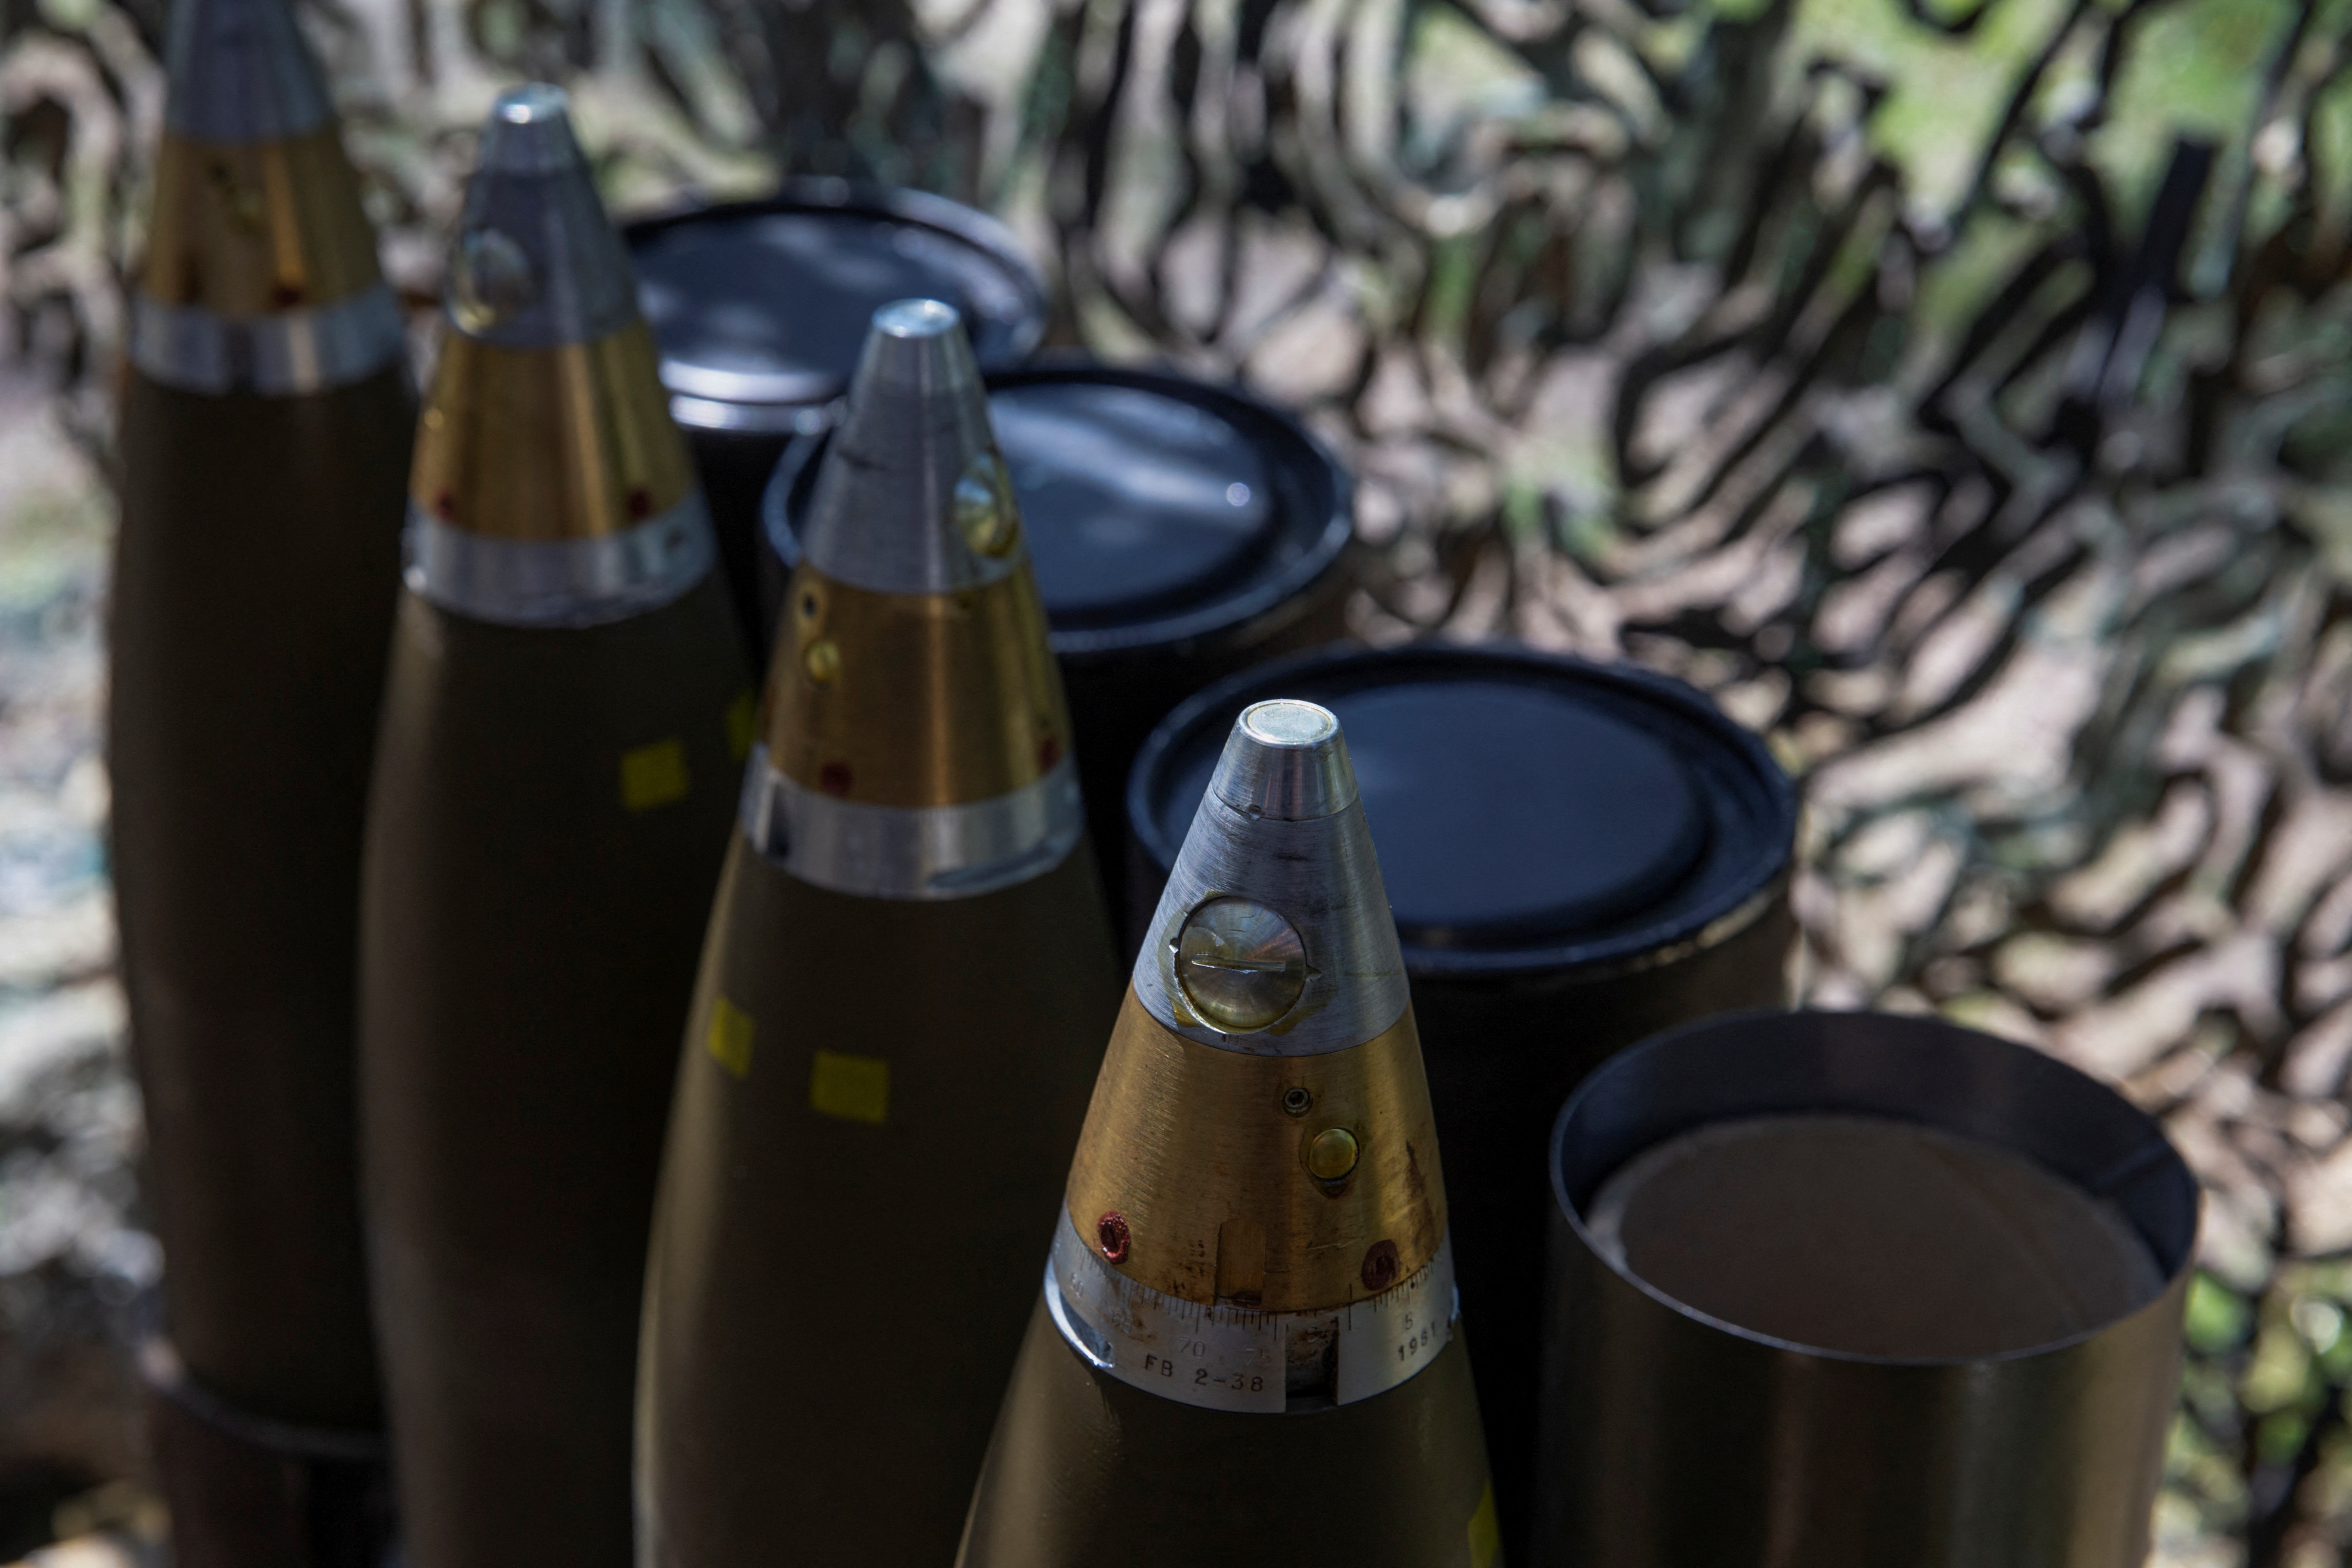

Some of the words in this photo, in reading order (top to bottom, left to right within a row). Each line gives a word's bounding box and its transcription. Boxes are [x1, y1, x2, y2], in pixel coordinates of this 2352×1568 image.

[1404, 1311, 1414, 1331] 5
[1179, 1336, 1205, 1360] 70
[1398, 1321, 1436, 1362] 1981
[1245, 1348, 1272, 1366] 75
[1144, 1352, 1174, 1378] FB
[1194, 1366, 1264, 1392] 2-38
